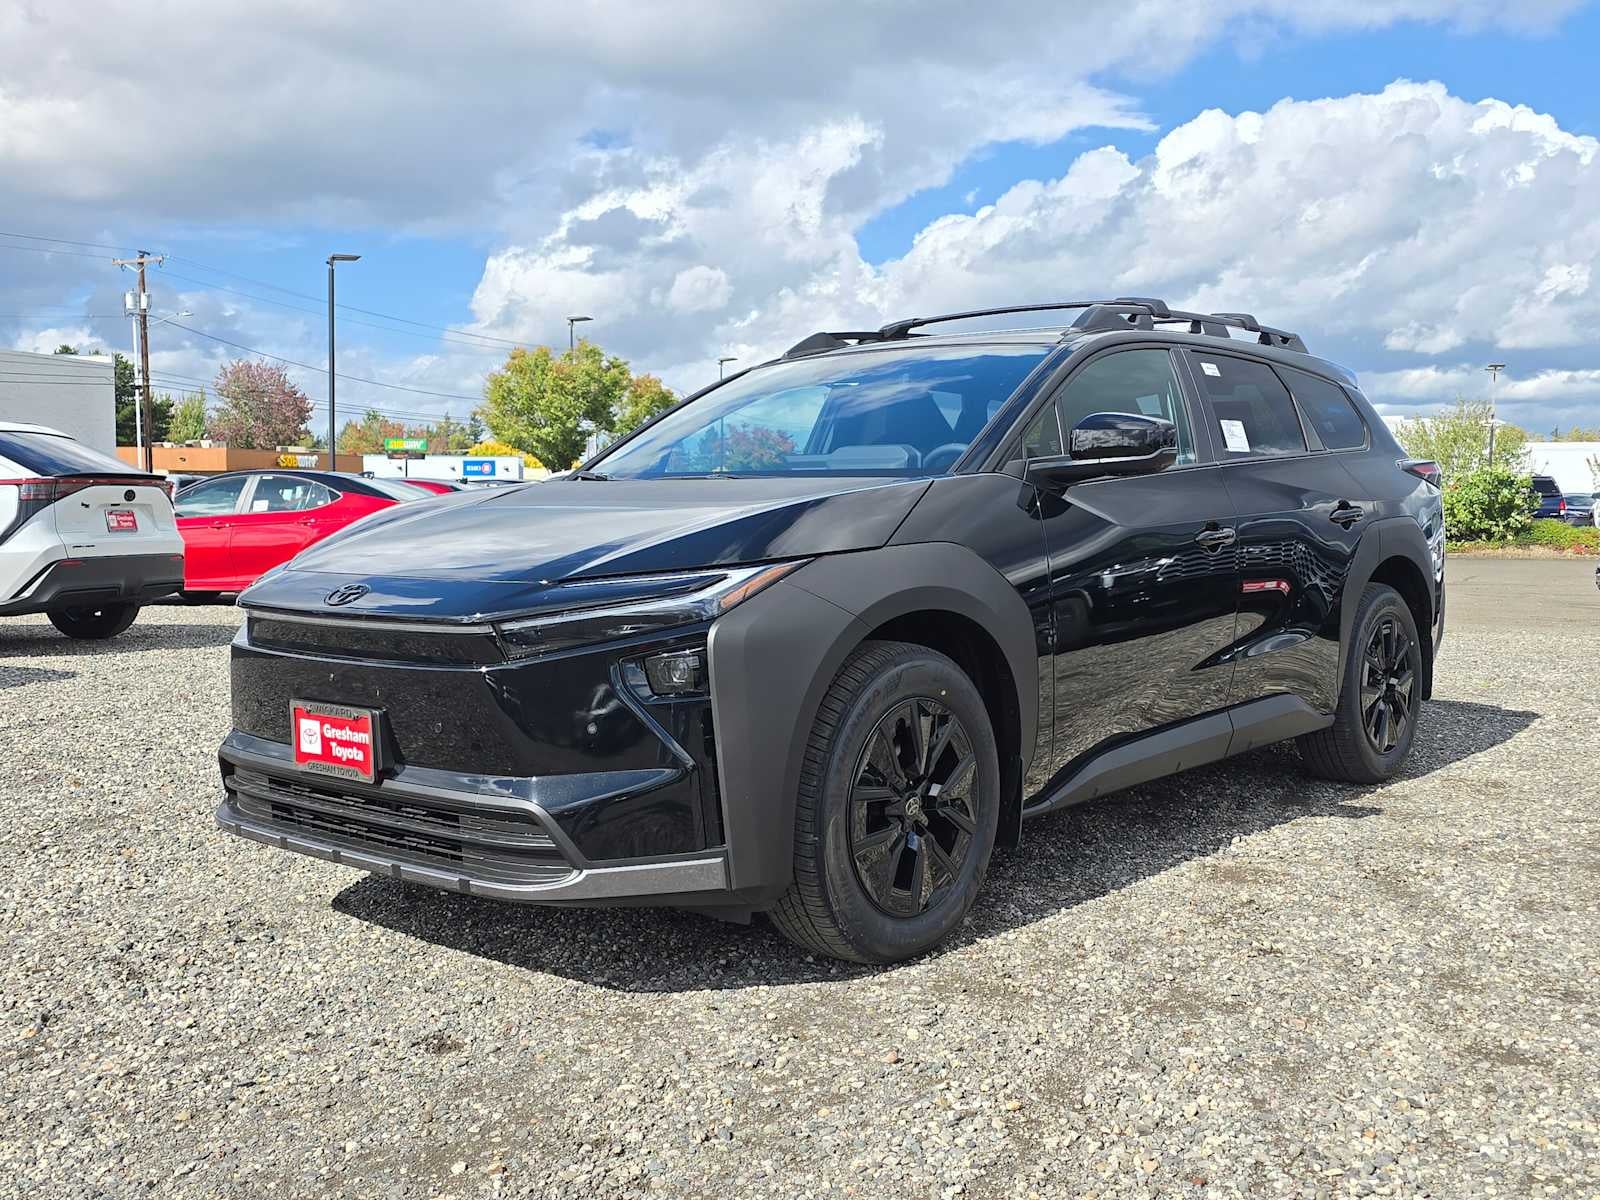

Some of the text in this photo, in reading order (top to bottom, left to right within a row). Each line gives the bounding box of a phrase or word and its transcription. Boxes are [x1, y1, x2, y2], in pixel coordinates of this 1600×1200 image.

[279, 454, 319, 468] SUBWAY
[323, 723, 369, 745] Gresham
[329, 741, 364, 762] Toyota
